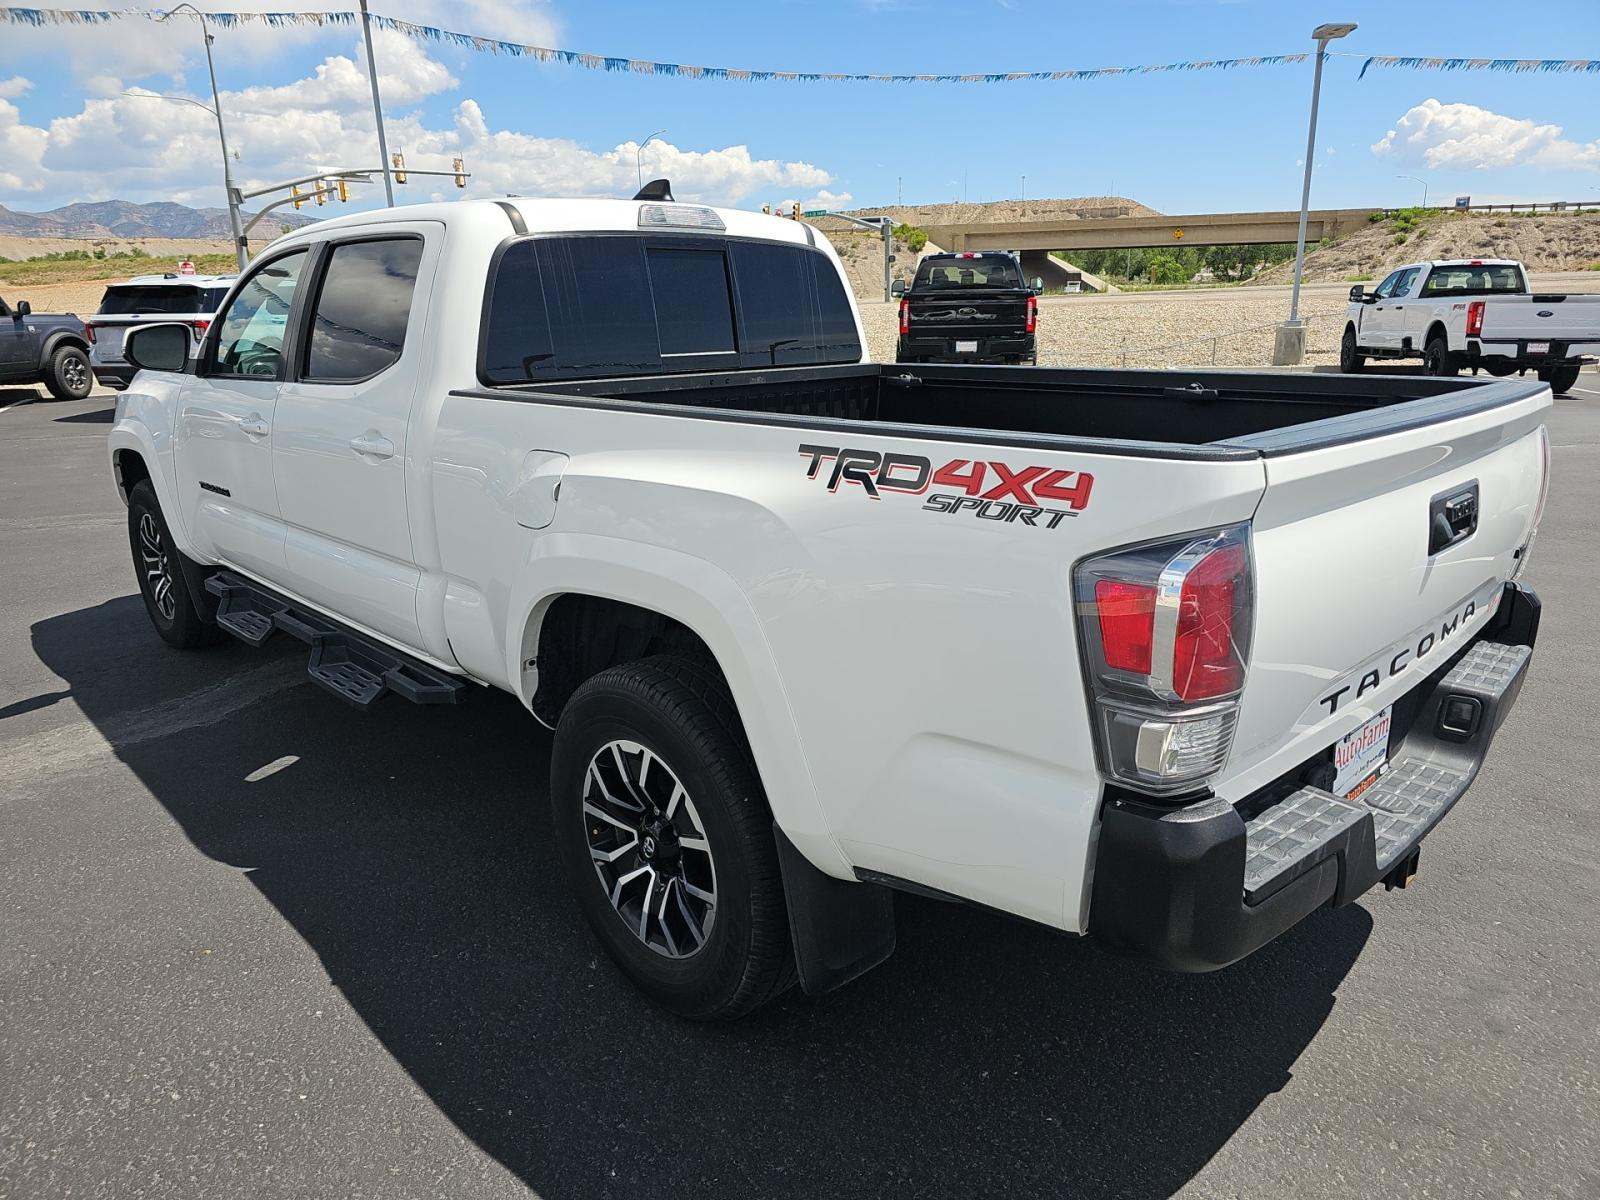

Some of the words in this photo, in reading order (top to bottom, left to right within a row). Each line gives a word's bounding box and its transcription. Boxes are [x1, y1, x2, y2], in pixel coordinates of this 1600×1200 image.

[798, 443, 933, 500] TRD
[932, 458, 1095, 510] 4X4
[921, 493, 1079, 530] SPORT
[1319, 600, 1476, 716] TACOMA
[1335, 717, 1389, 768] AutoFarm
